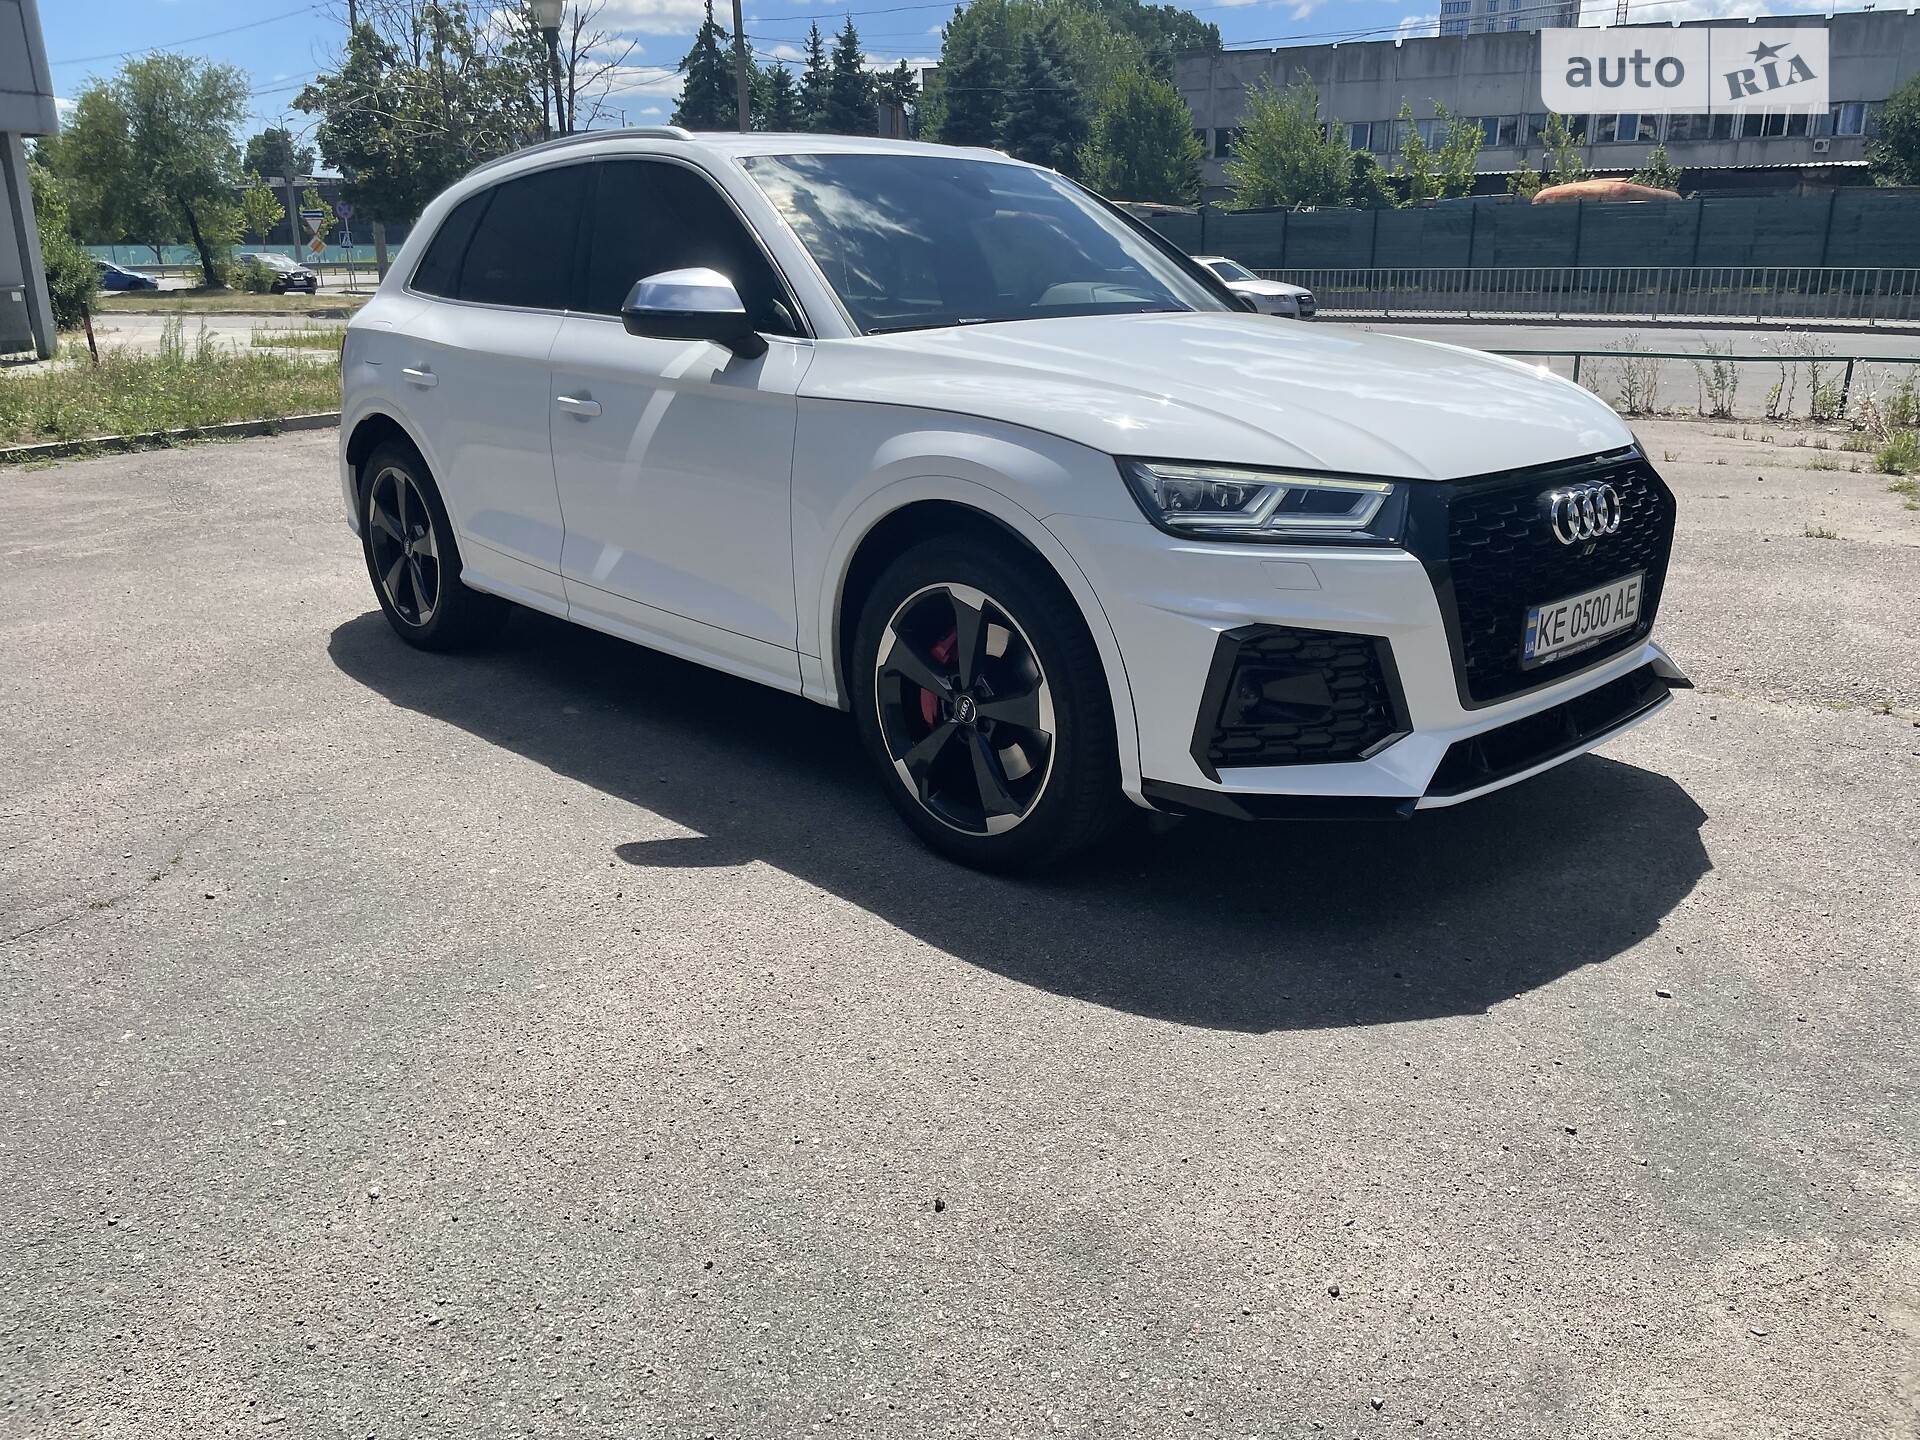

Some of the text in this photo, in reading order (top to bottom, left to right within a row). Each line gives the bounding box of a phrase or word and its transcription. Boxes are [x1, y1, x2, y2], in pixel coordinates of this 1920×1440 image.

[1537, 584, 1637, 650] KE 0500 AE
[1525, 642, 1534, 653] UA
